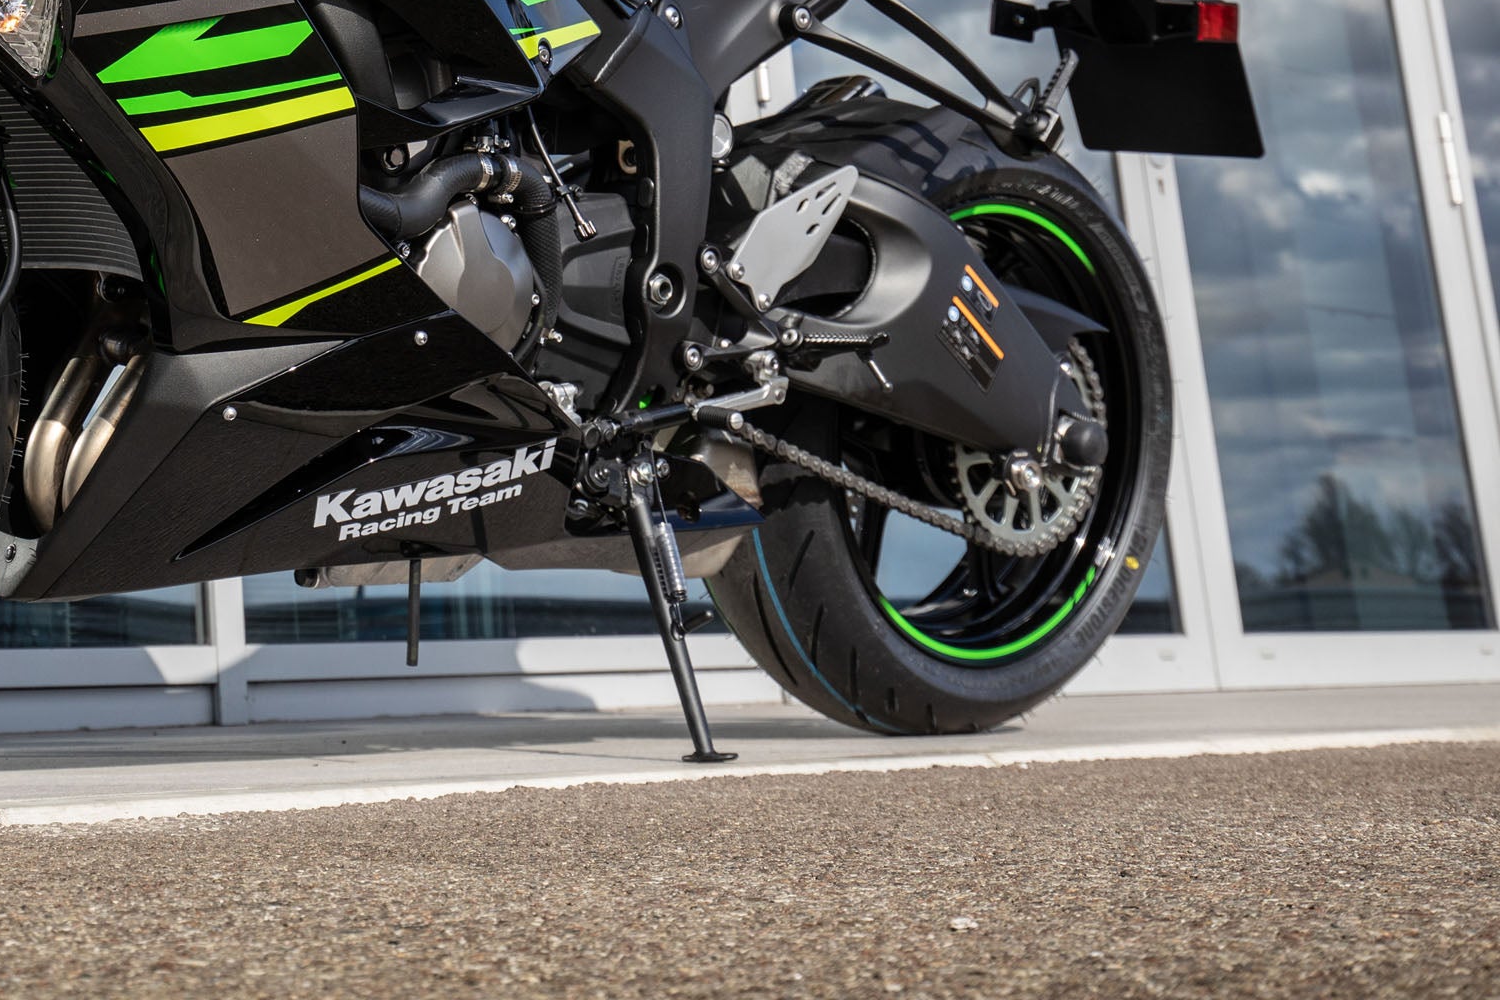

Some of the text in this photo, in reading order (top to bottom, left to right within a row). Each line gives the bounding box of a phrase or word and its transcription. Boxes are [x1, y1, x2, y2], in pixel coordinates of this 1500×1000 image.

[313, 436, 558, 528] Kawasaki
[338, 483, 523, 542] Racing Team
[1072, 528, 1149, 648] BRDGESTONE
